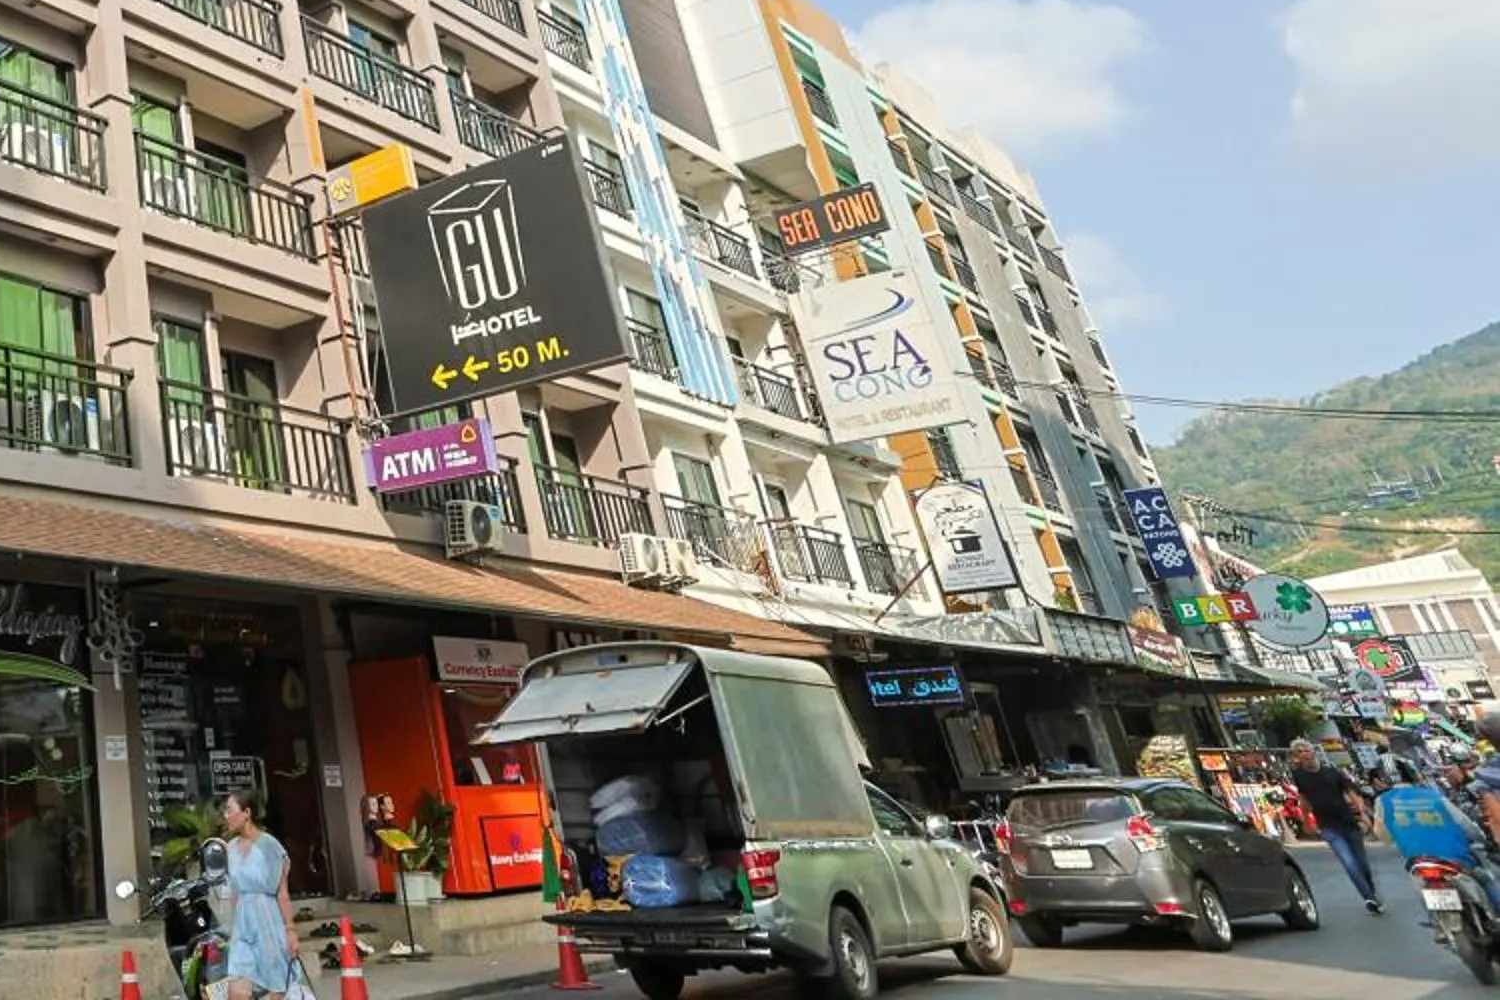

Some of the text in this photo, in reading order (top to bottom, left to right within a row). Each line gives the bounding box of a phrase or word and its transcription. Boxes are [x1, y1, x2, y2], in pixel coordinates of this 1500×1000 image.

[779, 207, 821, 246] SEA
[446, 207, 520, 311] GU
[497, 336, 570, 374] 50 M.
[823, 328, 928, 382] SEA
[382, 447, 436, 482] ATM
[1180, 599, 1251, 619] BAR
